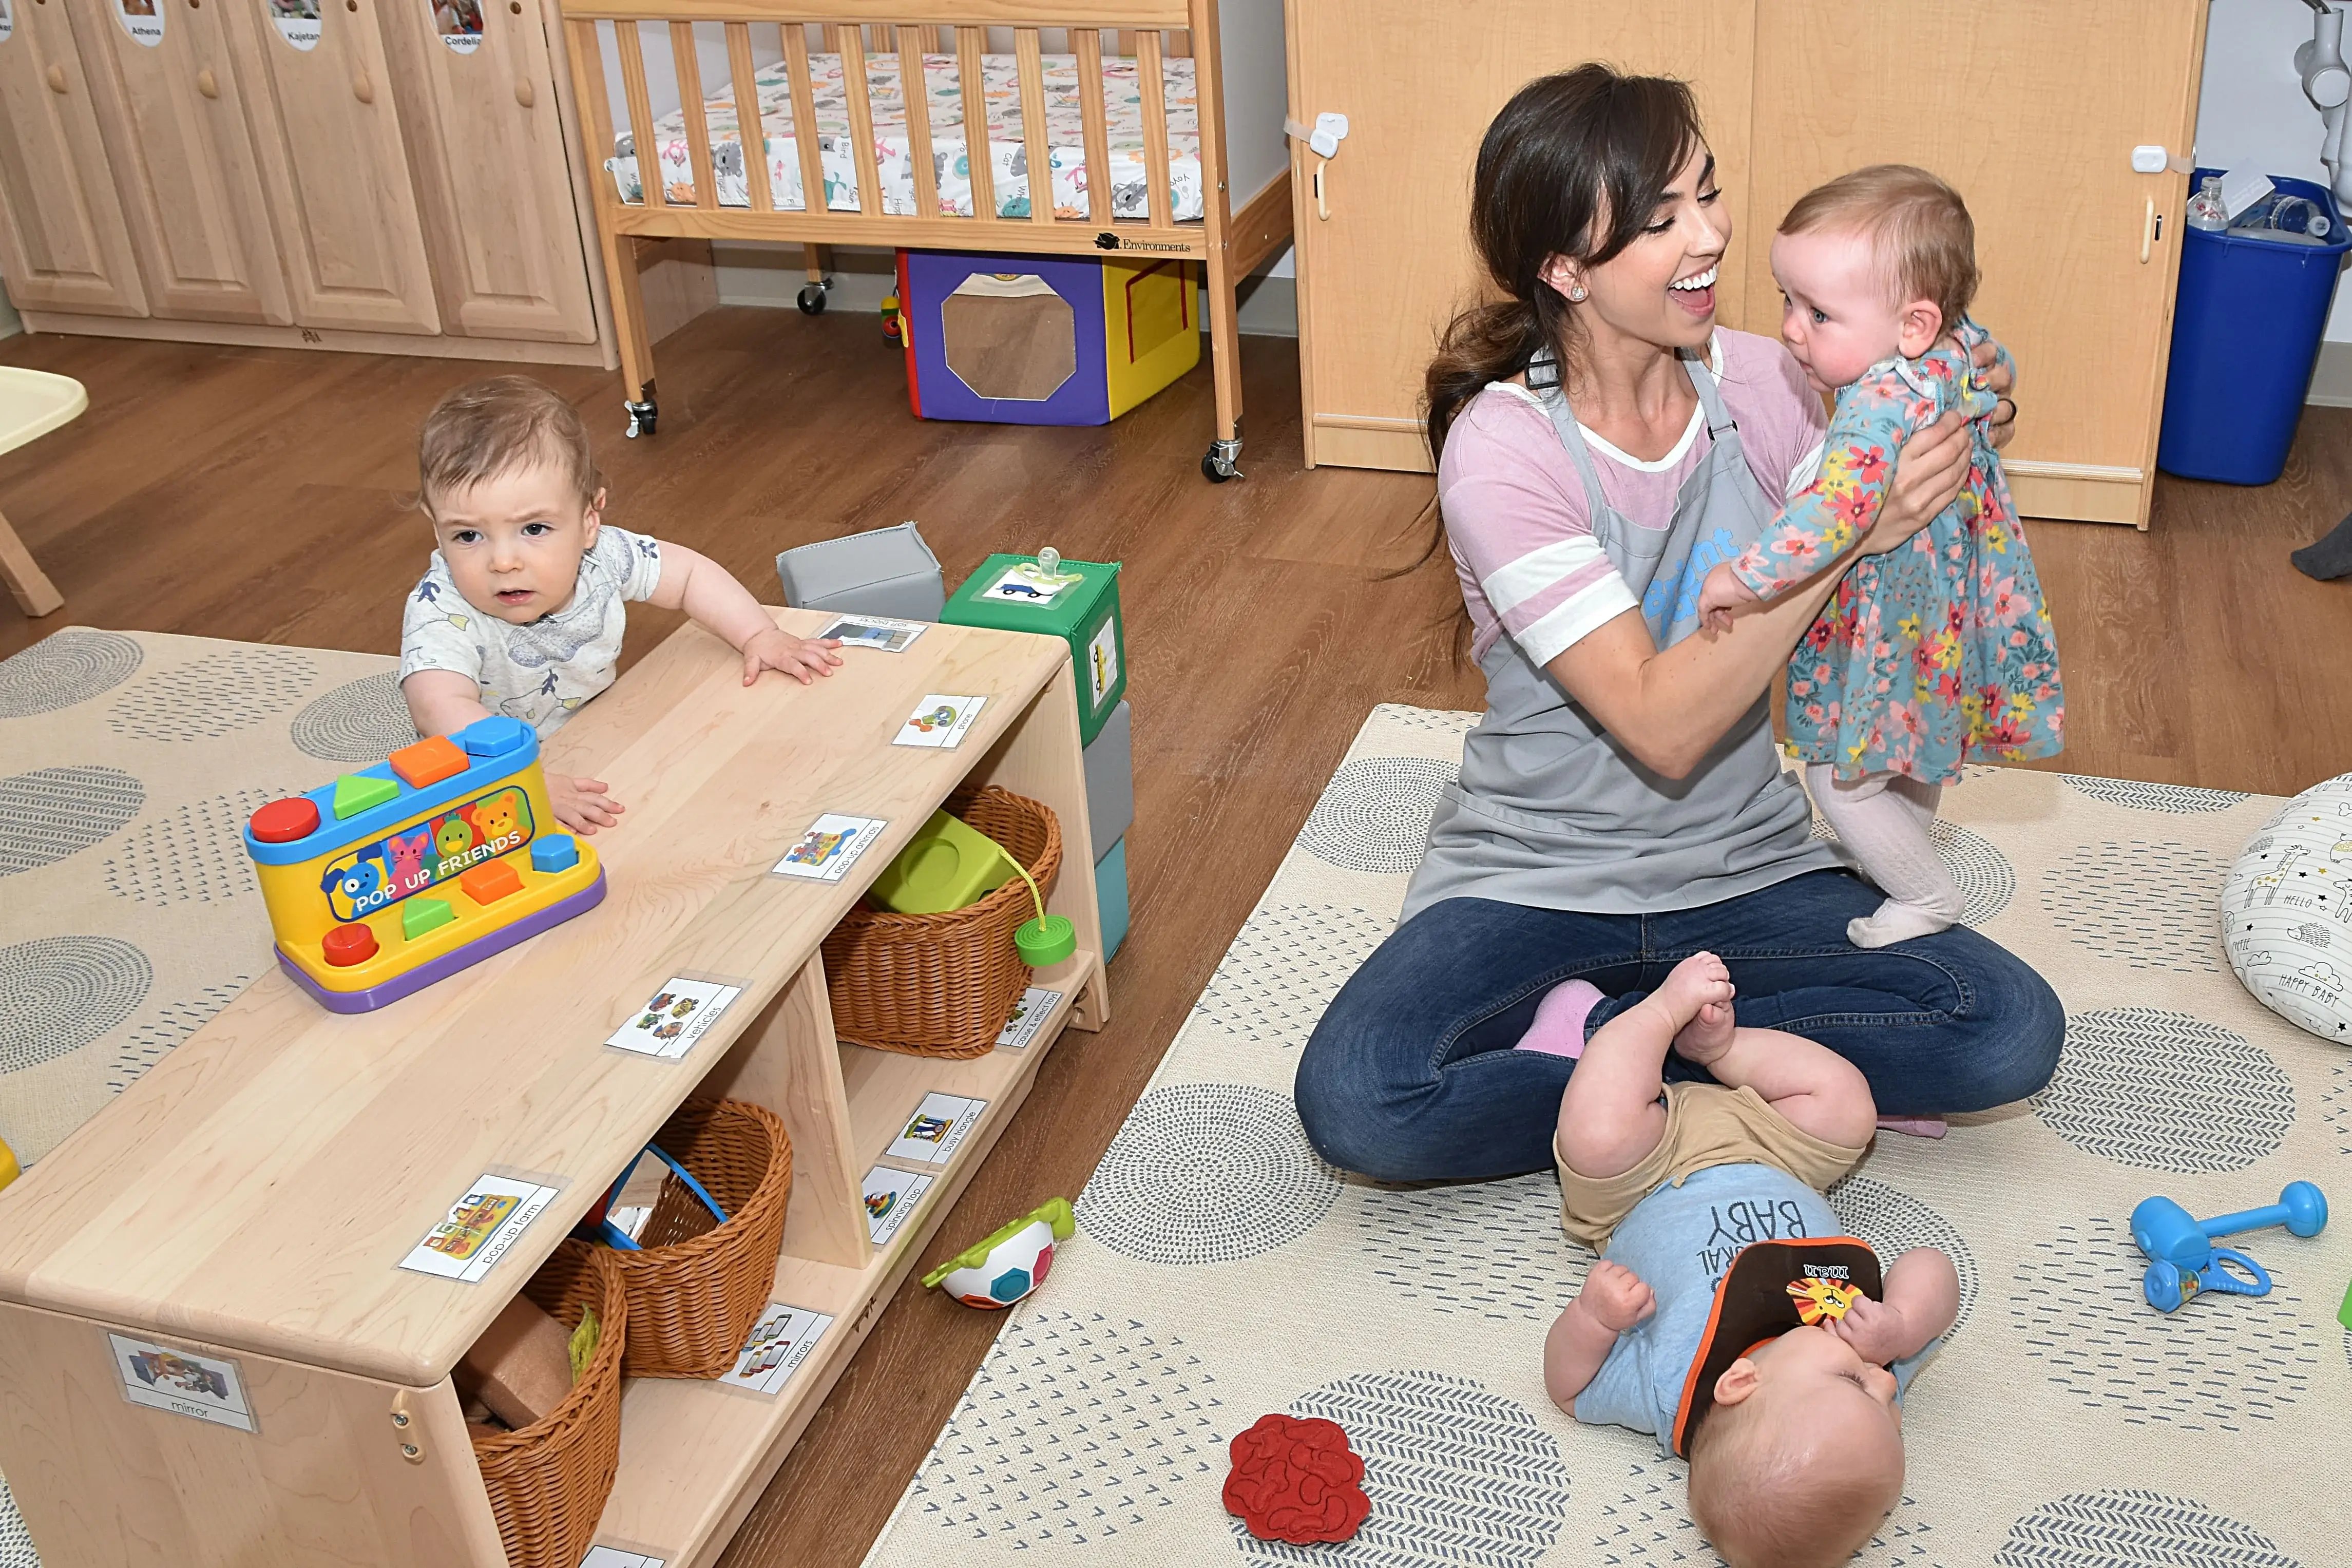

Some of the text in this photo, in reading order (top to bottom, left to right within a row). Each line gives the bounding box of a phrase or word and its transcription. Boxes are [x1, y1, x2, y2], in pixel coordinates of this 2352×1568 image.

[132, 27, 161, 35] Athena
[839, 142, 850, 159] Bird
[1003, 153, 1012, 167] Cat
[1123, 239, 1191, 252] Environments
[958, 713, 972, 730] phone
[834, 826, 879, 873] pop-up animals
[356, 830, 521, 912] POP UP FRIENDS
[2283, 895, 2312, 908] HELLO
[2279, 974, 2340, 1008] HAPPY BABY
[686, 1006, 721, 1039] vehicles
[1018, 1028, 1033, 1045] cause
[1034, 1005, 1049, 1022] effect
[1045, 993, 1058, 1004] toys
[942, 1112, 976, 1152] busy triangle
[886, 1189, 921, 1231] spinning top
[1707, 1199, 1807, 1246] BABY
[482, 1203, 541, 1265] pop-up farm
[1804, 1264, 1849, 1280] man
[787, 1339, 813, 1369] mirrors
[171, 1401, 209, 1418] mirror
